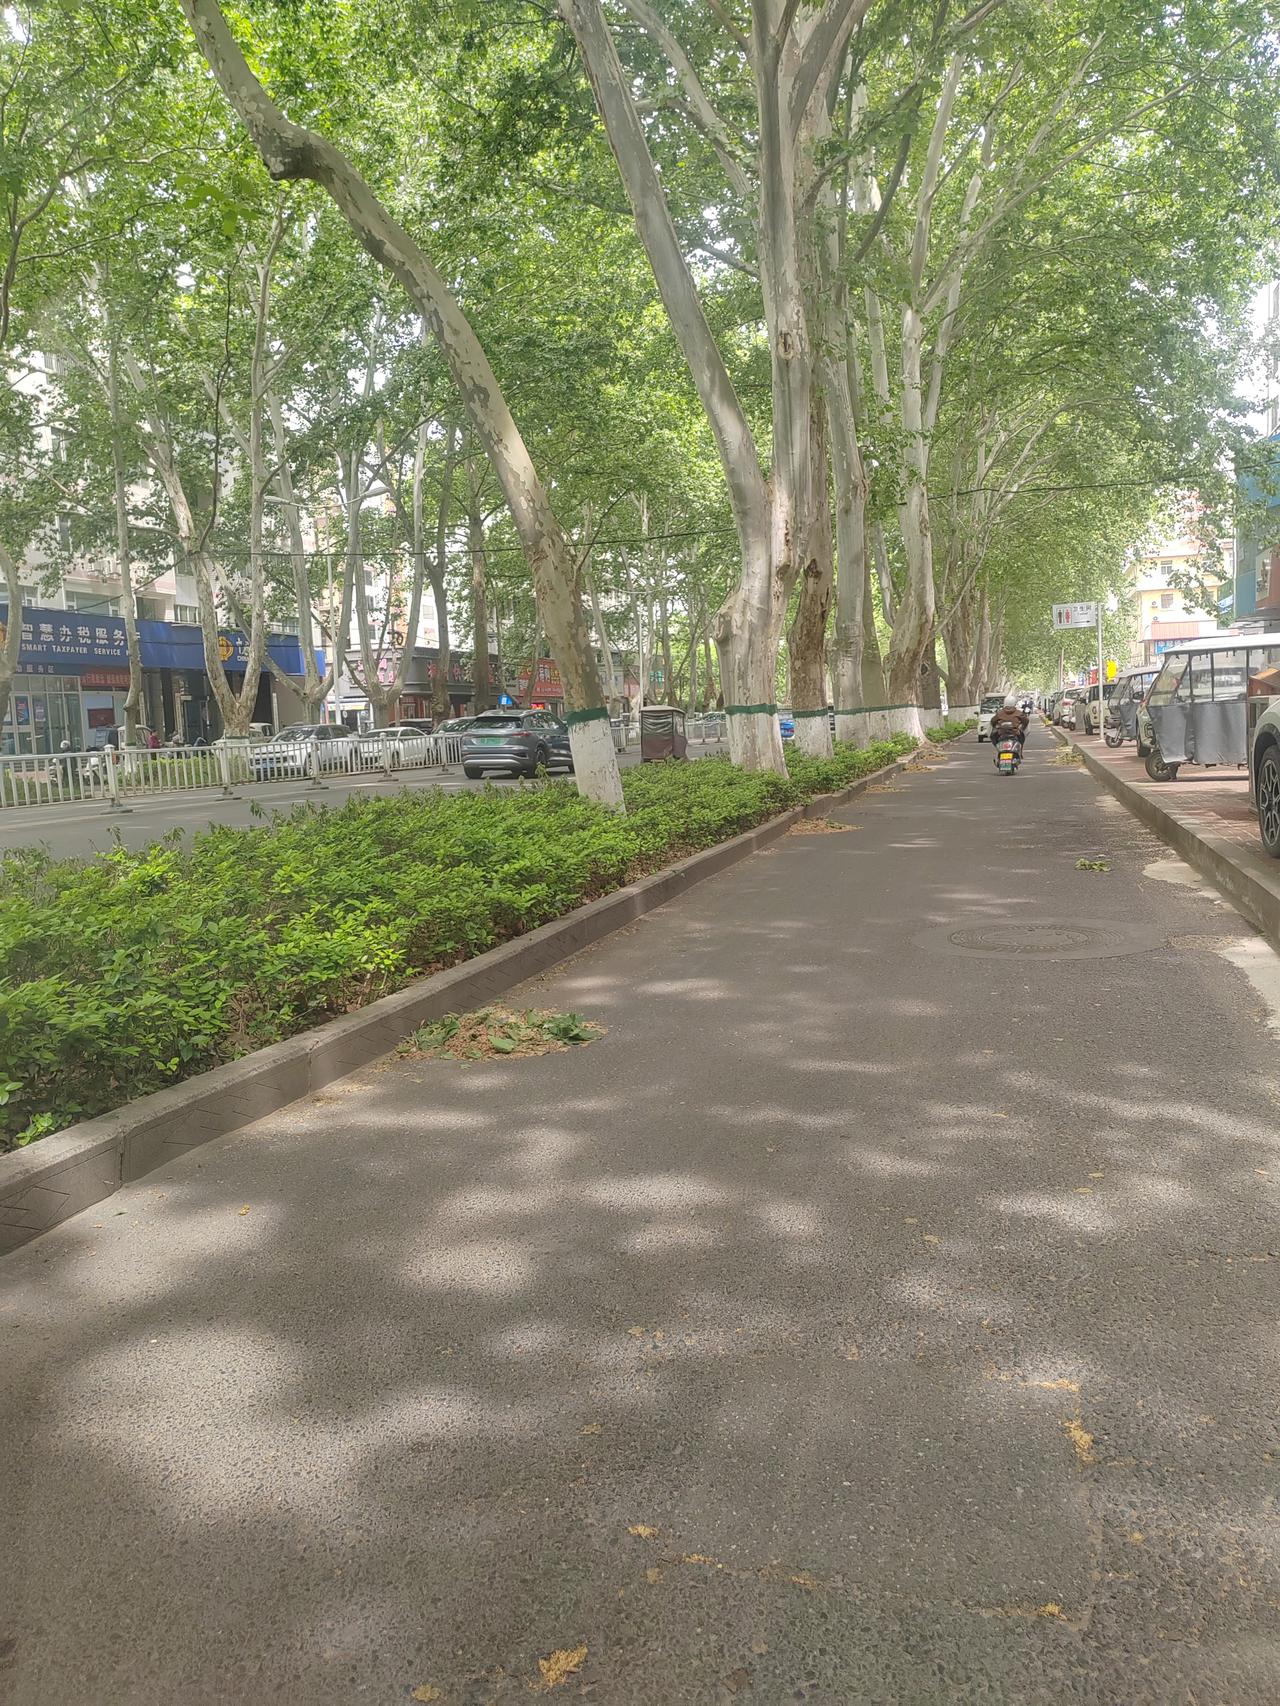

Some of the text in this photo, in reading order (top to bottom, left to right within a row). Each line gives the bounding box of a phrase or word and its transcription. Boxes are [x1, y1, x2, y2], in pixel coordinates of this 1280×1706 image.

[22, 623, 140, 646] 智慧办税服务
[21, 643, 47, 652] SMART
[52, 645, 88, 654] TAXPAYER
[94, 647, 121, 656] SERVICE
